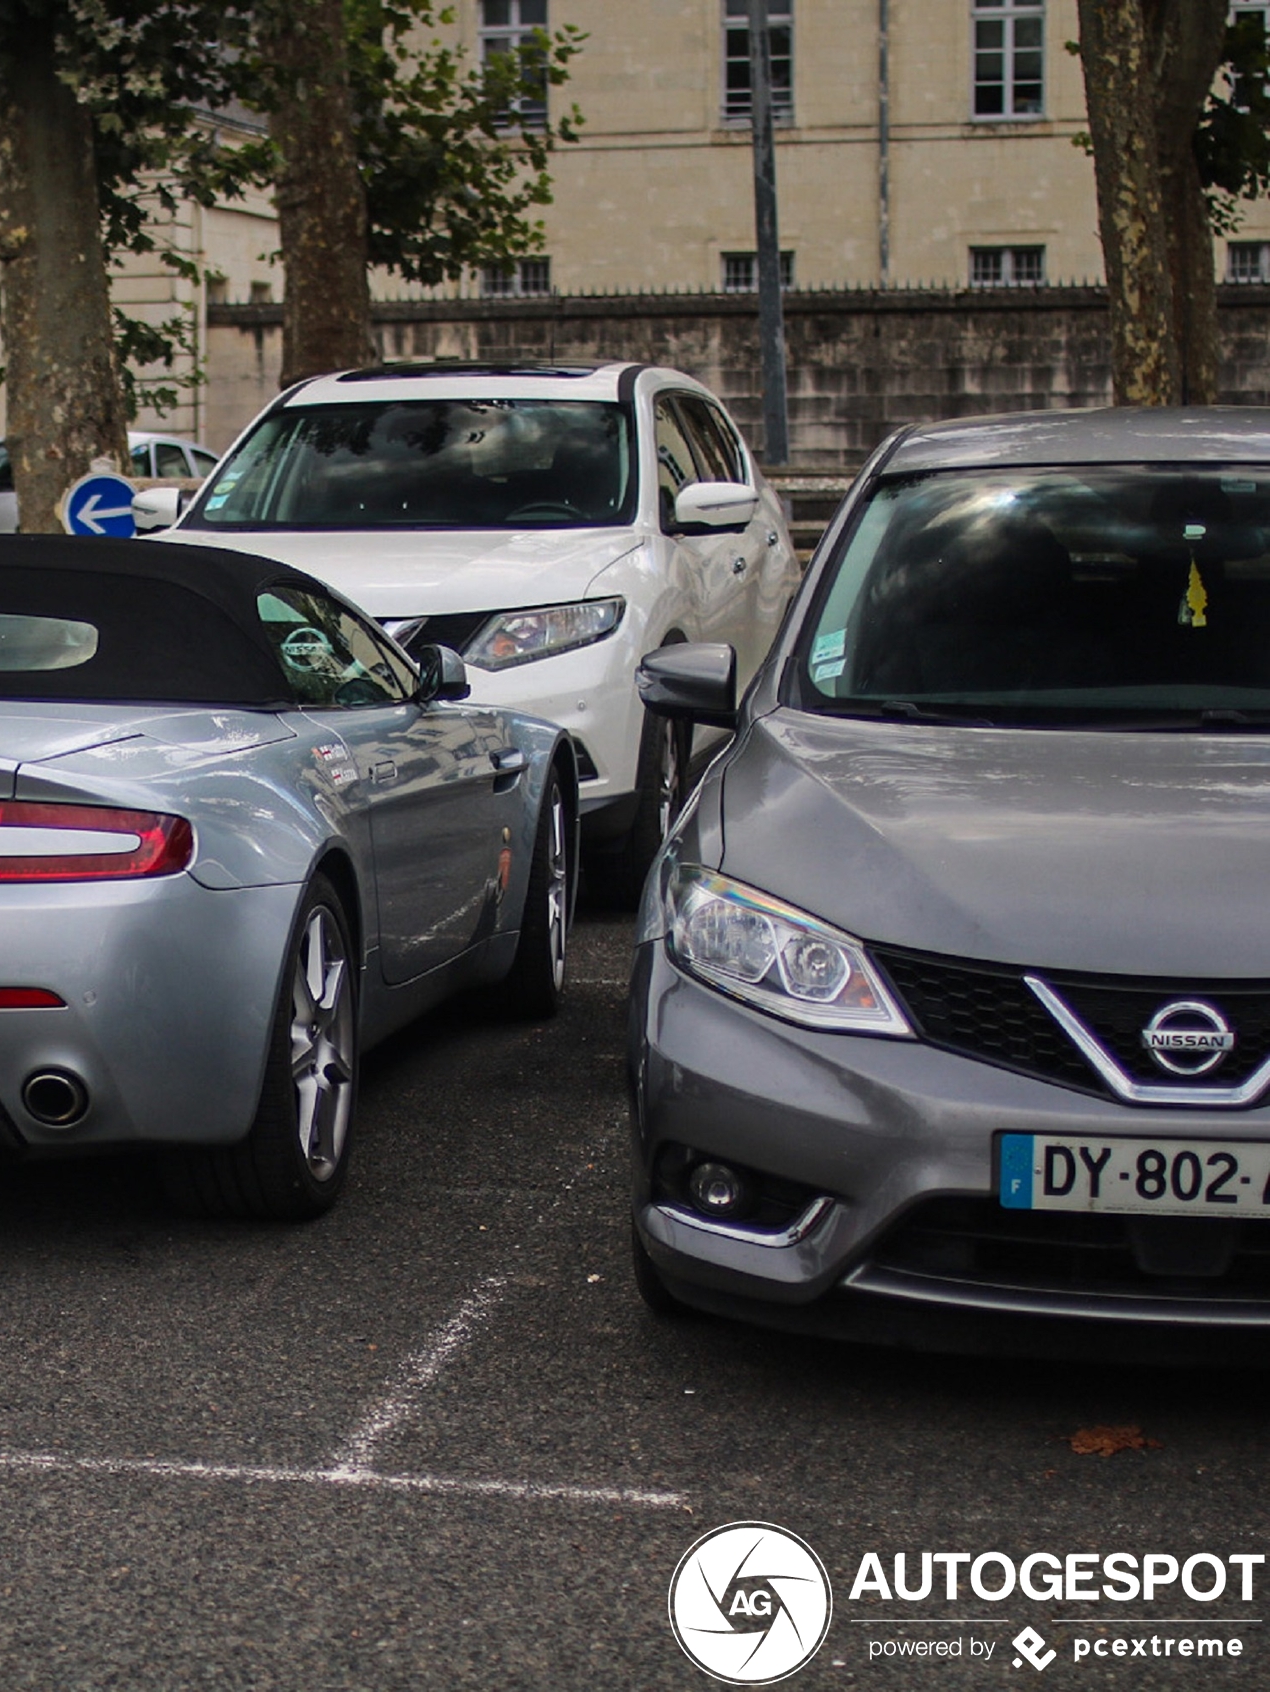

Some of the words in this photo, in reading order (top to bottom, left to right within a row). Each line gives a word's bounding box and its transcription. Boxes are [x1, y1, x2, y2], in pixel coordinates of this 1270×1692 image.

[1151, 1034, 1225, 1047] NISSAN
[1043, 1145, 1270, 1204] DY-802-
[1011, 1179, 1021, 1194] F
